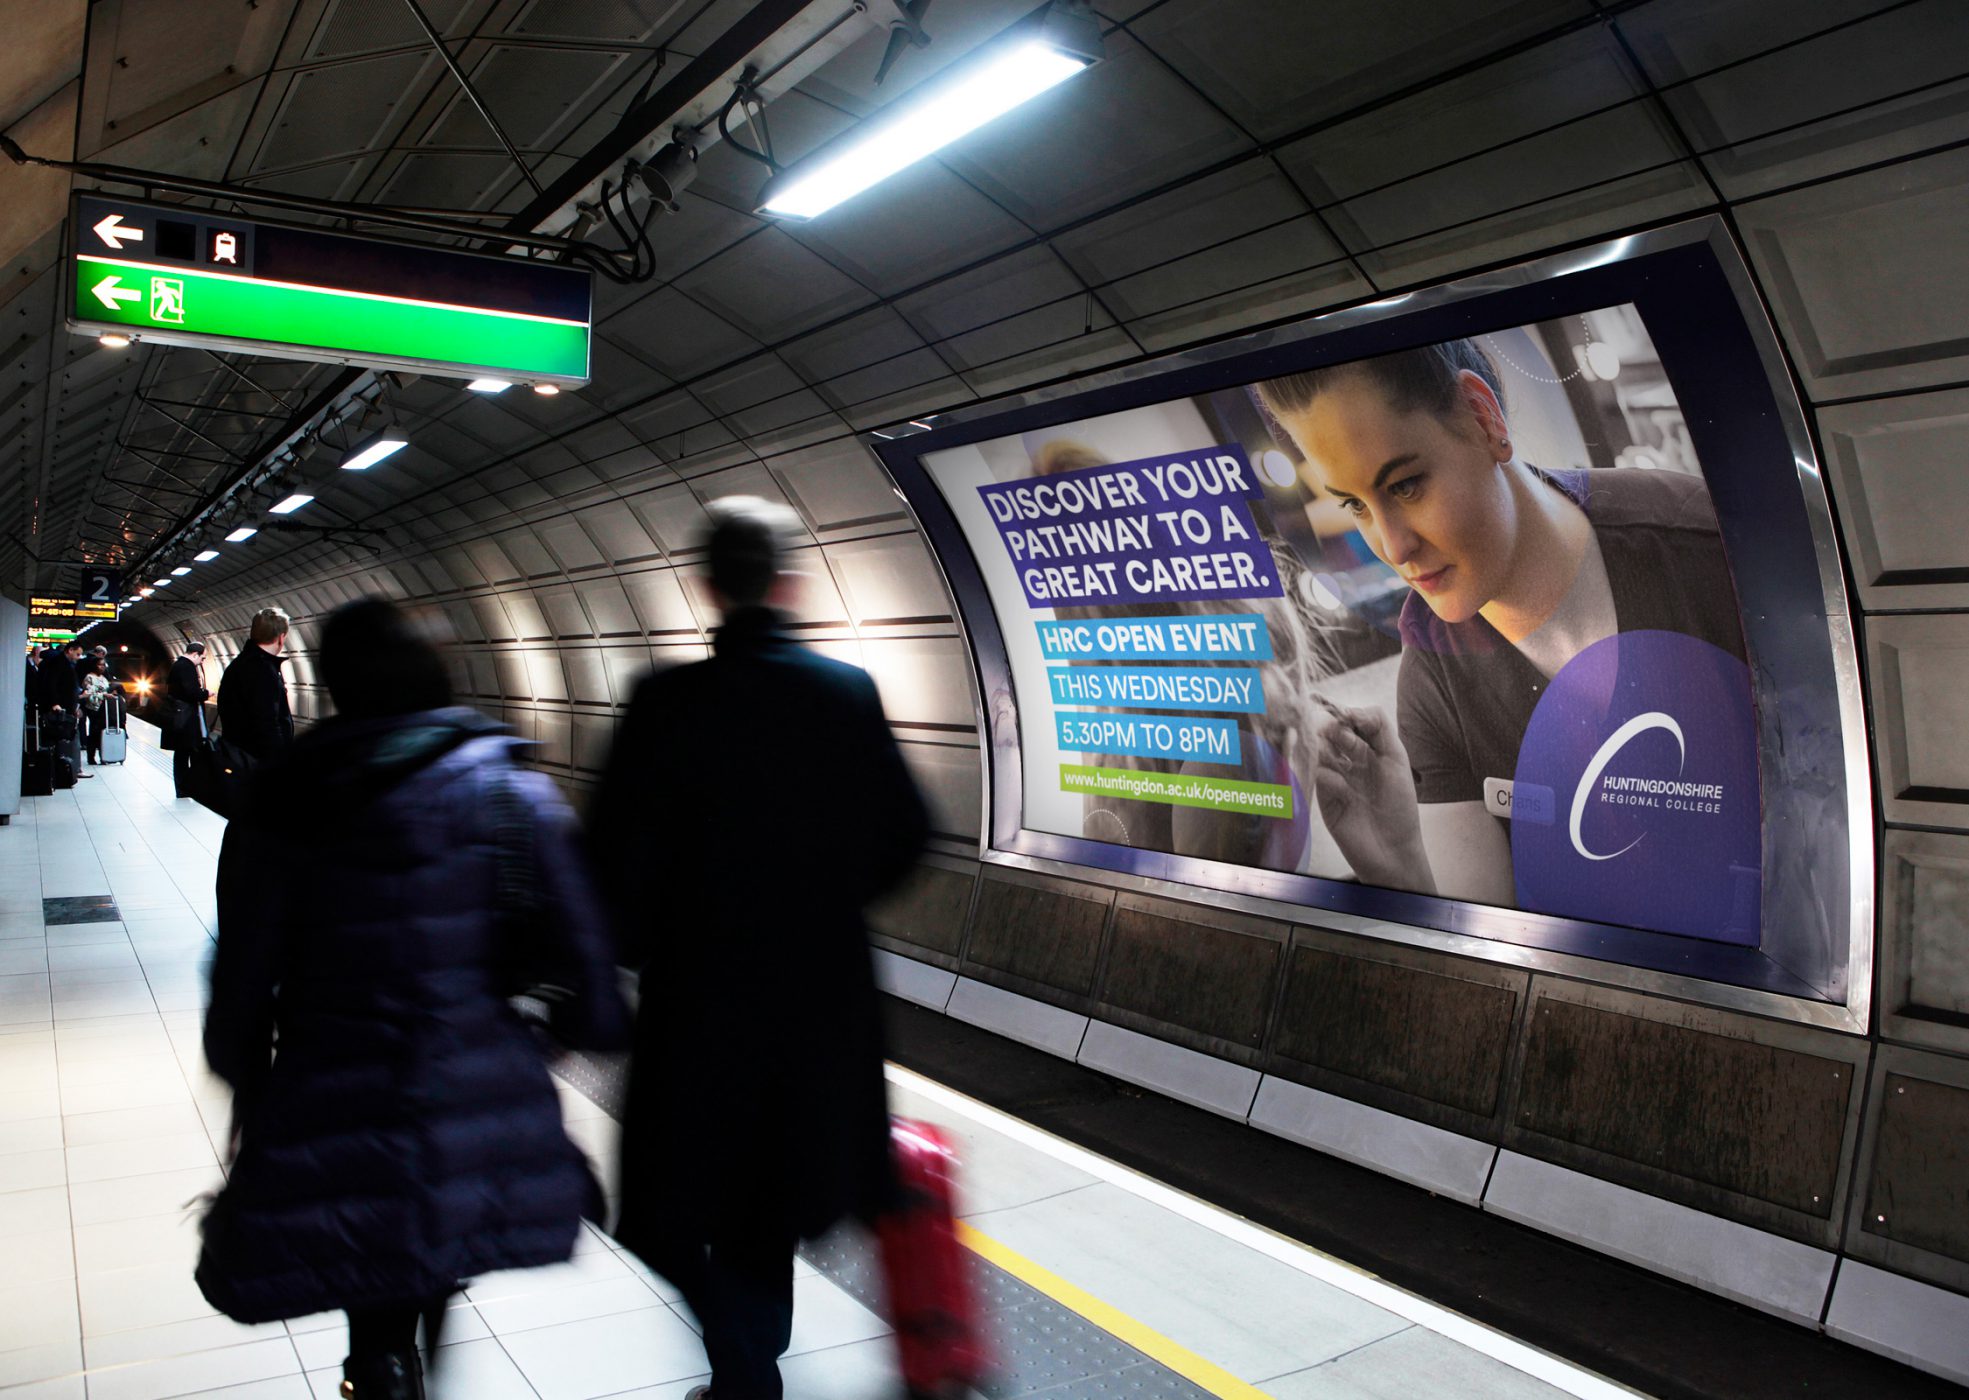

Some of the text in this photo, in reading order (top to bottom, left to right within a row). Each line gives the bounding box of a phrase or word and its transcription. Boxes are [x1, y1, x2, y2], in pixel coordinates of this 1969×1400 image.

[986, 455, 1250, 523] DISCOVER YOUR
[1005, 505, 1250, 561] PATHWAY TO A
[91, 576, 110, 600] 2
[1024, 551, 1271, 600] GREAT CAREER.
[1042, 622, 1257, 653] HRC OPEN EVENT
[1053, 674, 1252, 704] THIS WEDNESDAY
[1062, 721, 1230, 755] 5.30PM TO 8PM
[1064, 771, 1285, 810] www.huntingdon.ac.uk/openevents
[1601, 793, 1721, 814] REGIONAL COLLEGE
[1603, 776, 1723, 800] HUNTINGDONSHIRE
